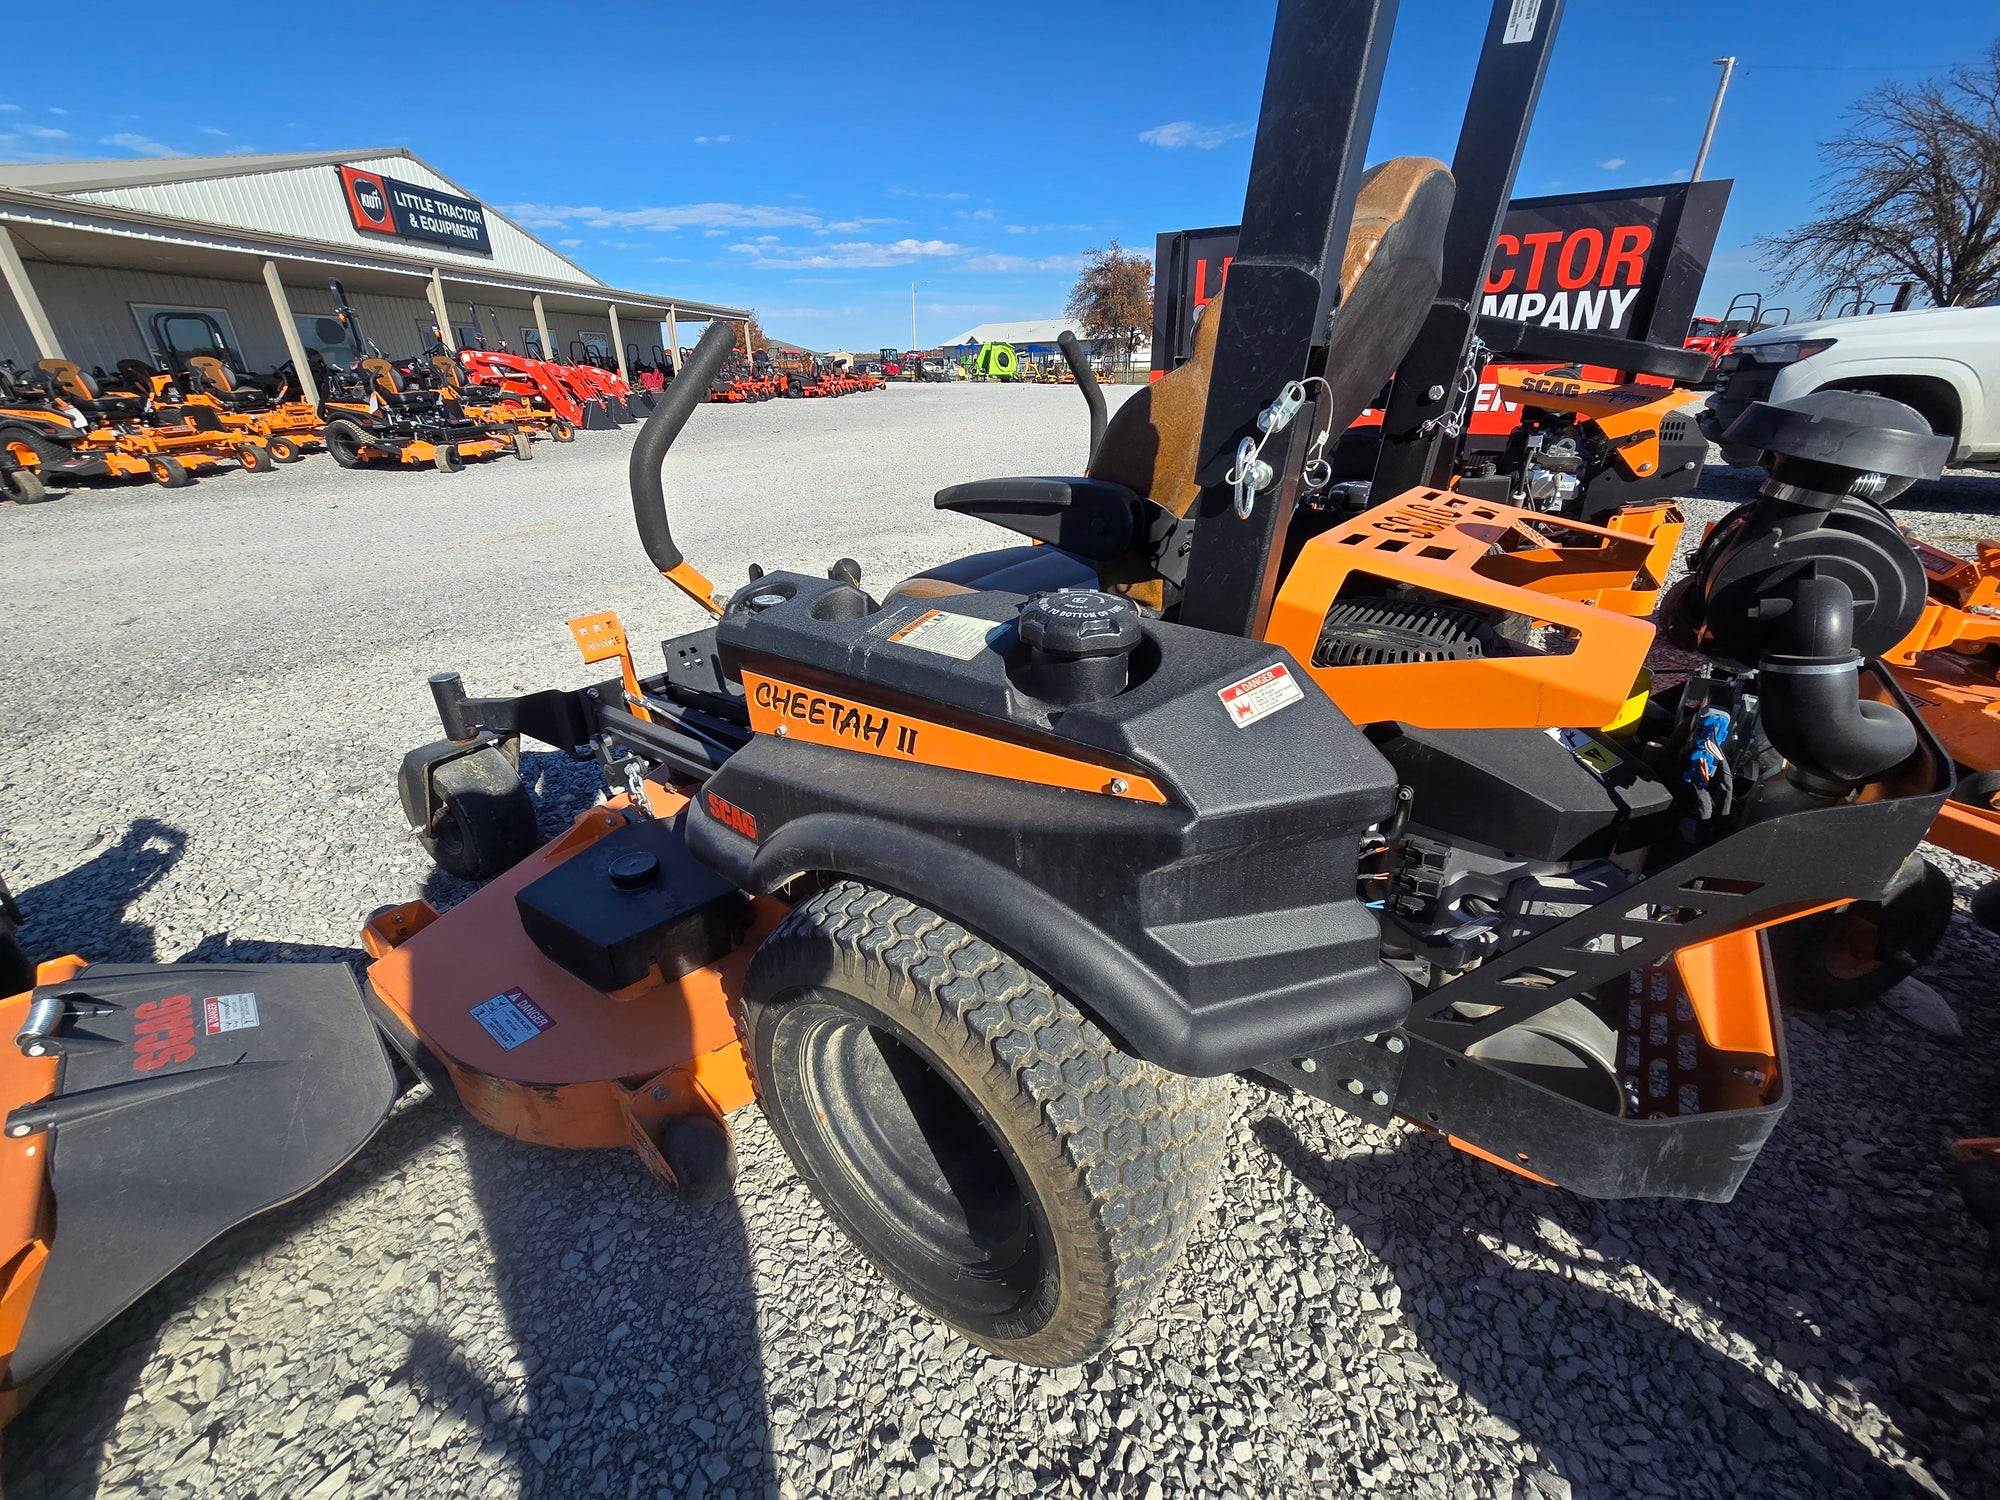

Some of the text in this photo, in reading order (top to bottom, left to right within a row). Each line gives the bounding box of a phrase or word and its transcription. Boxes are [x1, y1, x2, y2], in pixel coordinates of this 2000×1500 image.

[393, 190, 483, 225] LITTLE TRACTOR
[409, 213, 480, 241] & EQUIPMENT
[1483, 225, 1653, 294] CTOR
[1481, 288, 1641, 331] MPANY
[1520, 377, 1582, 398] SCAG
[1371, 503, 1463, 539] SCAG
[1059, 609, 1097, 619] BOTTOM
[586, 636, 621, 652] BRAKE
[1241, 671, 1276, 692] DANGER
[754, 682, 919, 756] CHEETAH II
[708, 792, 757, 839] SCAG
[516, 999, 549, 1028] DANGER
[133, 994, 196, 1072] SCAG
